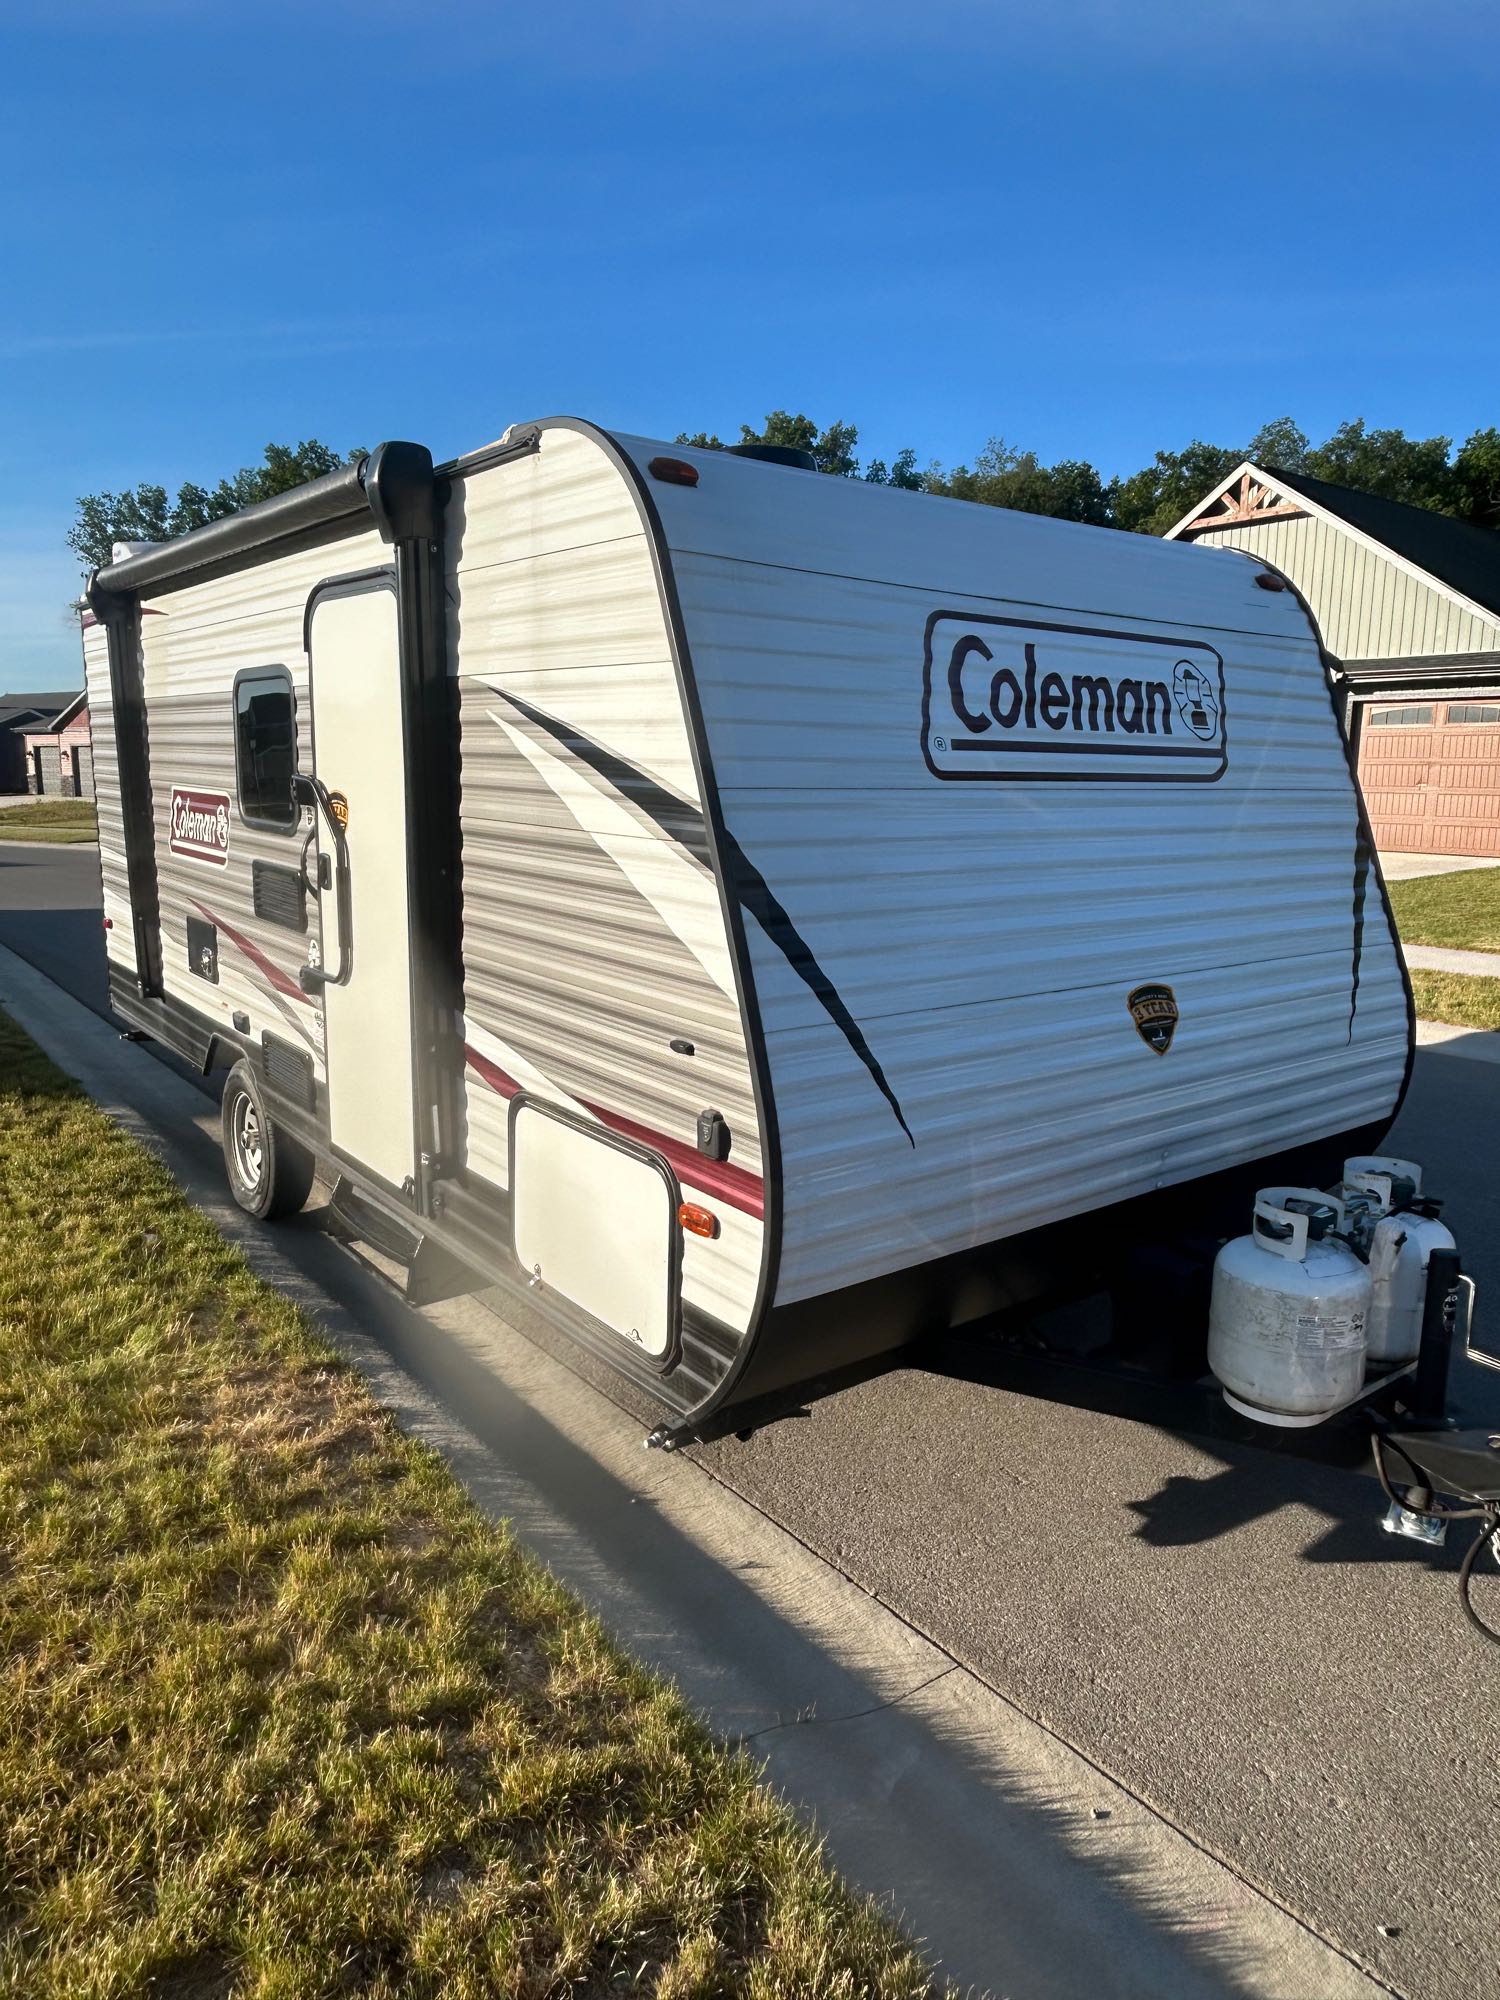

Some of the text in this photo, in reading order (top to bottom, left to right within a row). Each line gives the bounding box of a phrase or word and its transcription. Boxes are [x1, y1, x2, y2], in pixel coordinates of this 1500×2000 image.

[948, 635, 1173, 734] Coleman
[173, 795, 217, 844] Coleman
[1143, 1001, 1176, 1016] YEAR
